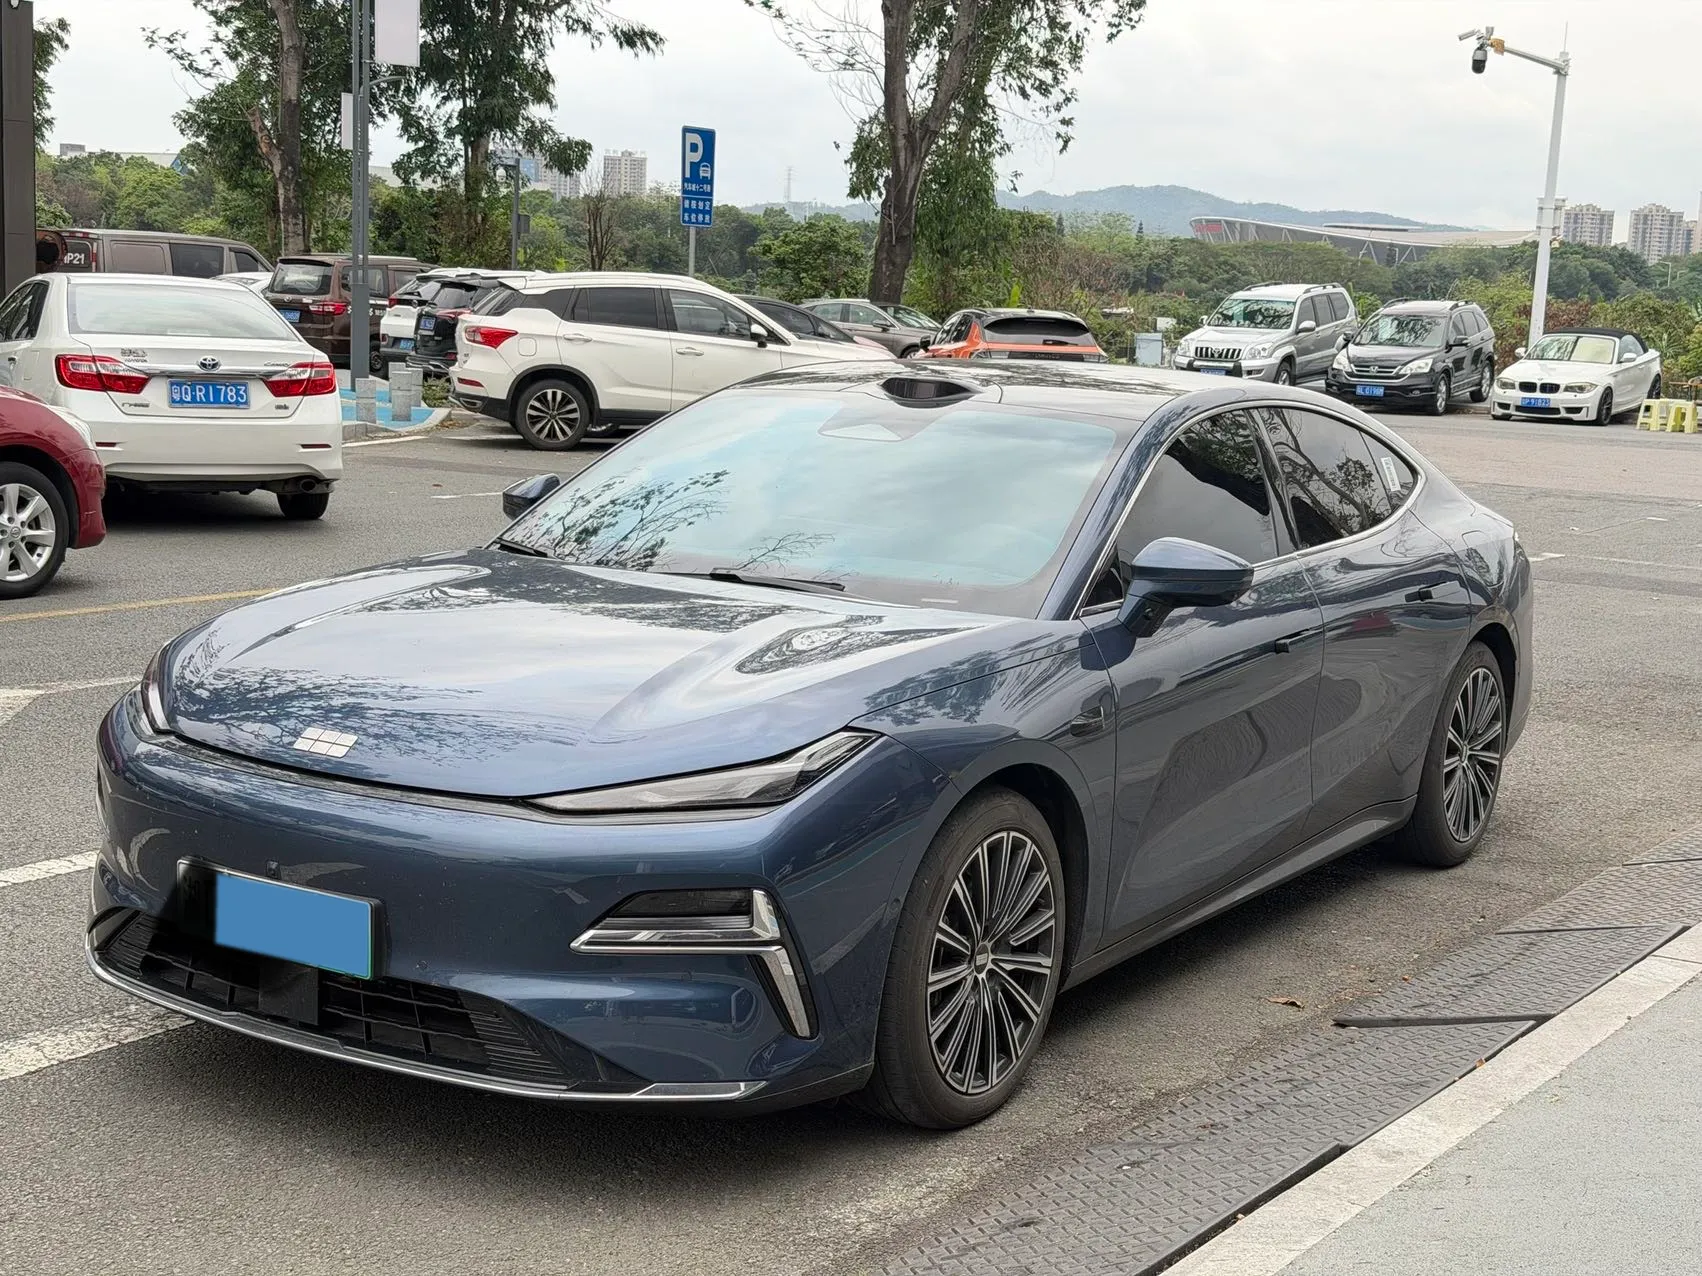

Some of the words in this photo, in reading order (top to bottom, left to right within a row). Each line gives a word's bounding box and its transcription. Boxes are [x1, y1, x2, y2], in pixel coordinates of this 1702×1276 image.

[685, 132, 703, 178] P
[683, 199, 711, 211] 请按划定
[683, 212, 711, 223] 车位停放
